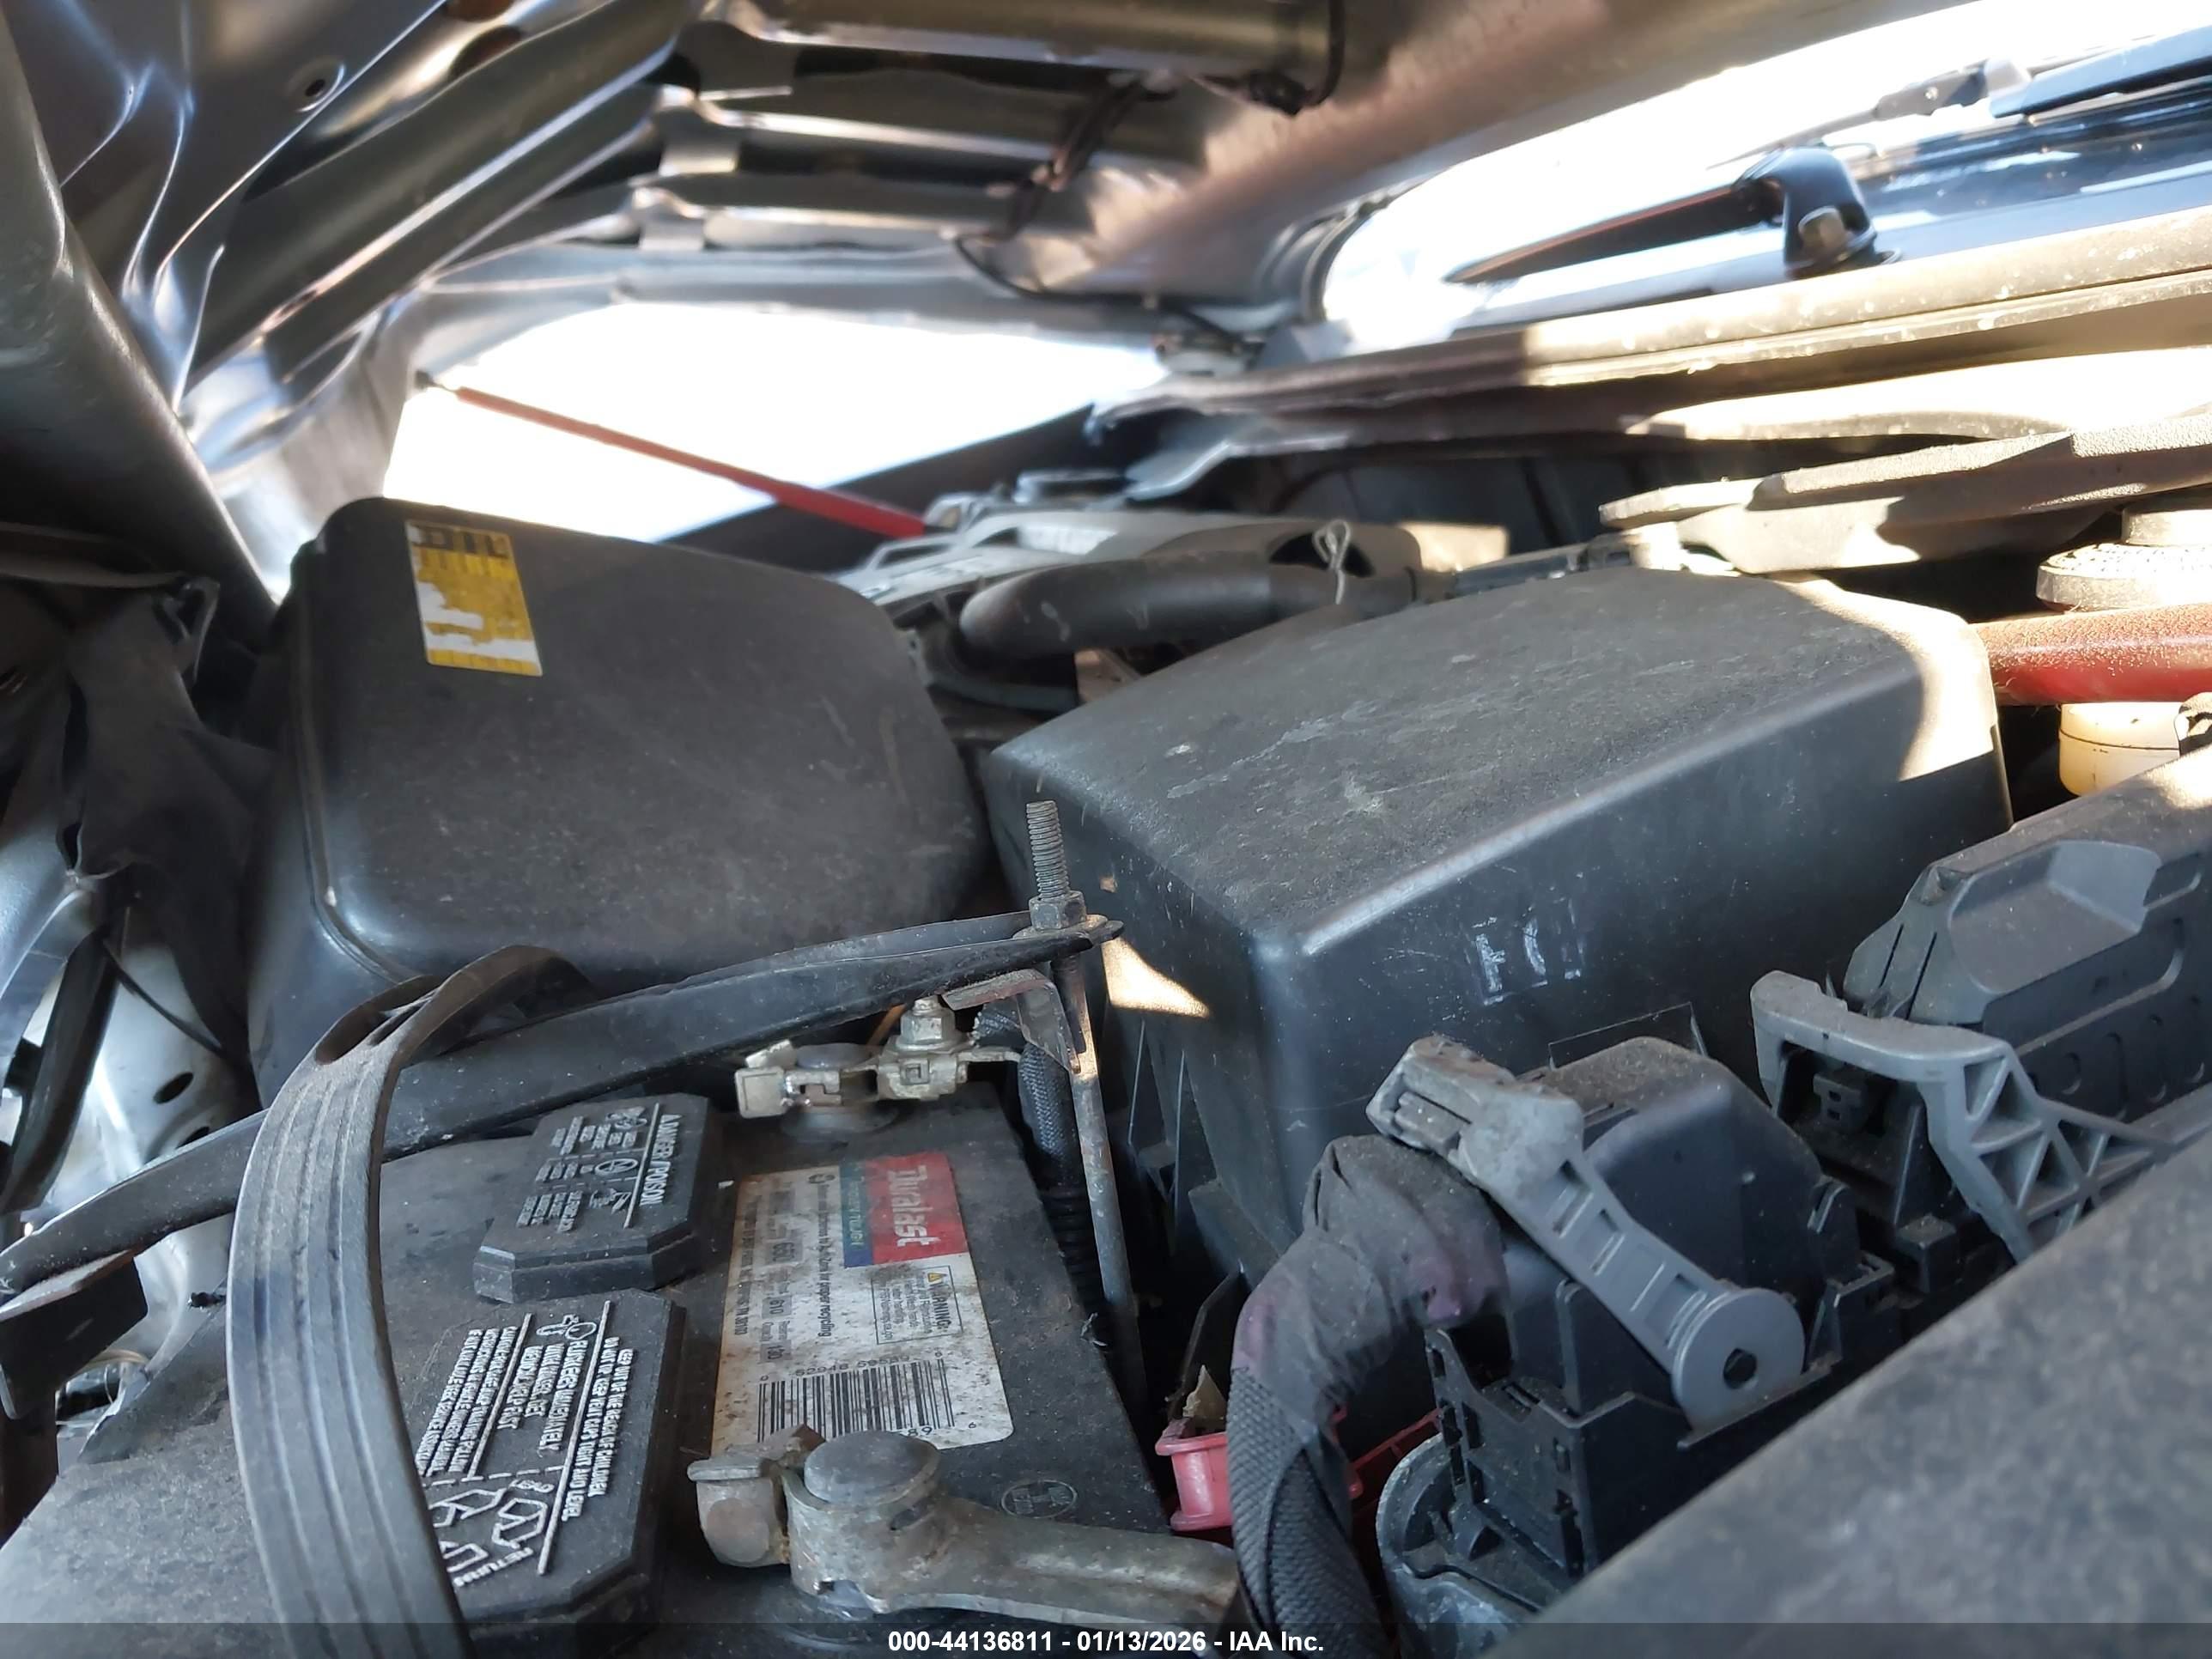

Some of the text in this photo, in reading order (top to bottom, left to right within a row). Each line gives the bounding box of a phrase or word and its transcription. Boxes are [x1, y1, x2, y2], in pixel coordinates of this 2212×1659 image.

[885, 1164, 941, 1248] Duralast
[815, 1281, 831, 1304] proper
[817, 1304, 835, 1337] recycling
[599, 1348, 617, 1363] NOT
[556, 1365, 580, 1390] EYES
[611, 1364, 630, 1381] OUT
[609, 1380, 627, 1393] OF
[522, 1398, 547, 1419] GET
[585, 1395, 605, 1417] VENT
[605, 1392, 625, 1409] THE
[495, 1404, 523, 1431] FAST
[599, 1407, 622, 1437] REACH
[580, 1417, 601, 1441] CAPS
[597, 1435, 616, 1449] OF
[574, 1440, 597, 1469] TIGHT
[568, 1468, 591, 1490] AND
